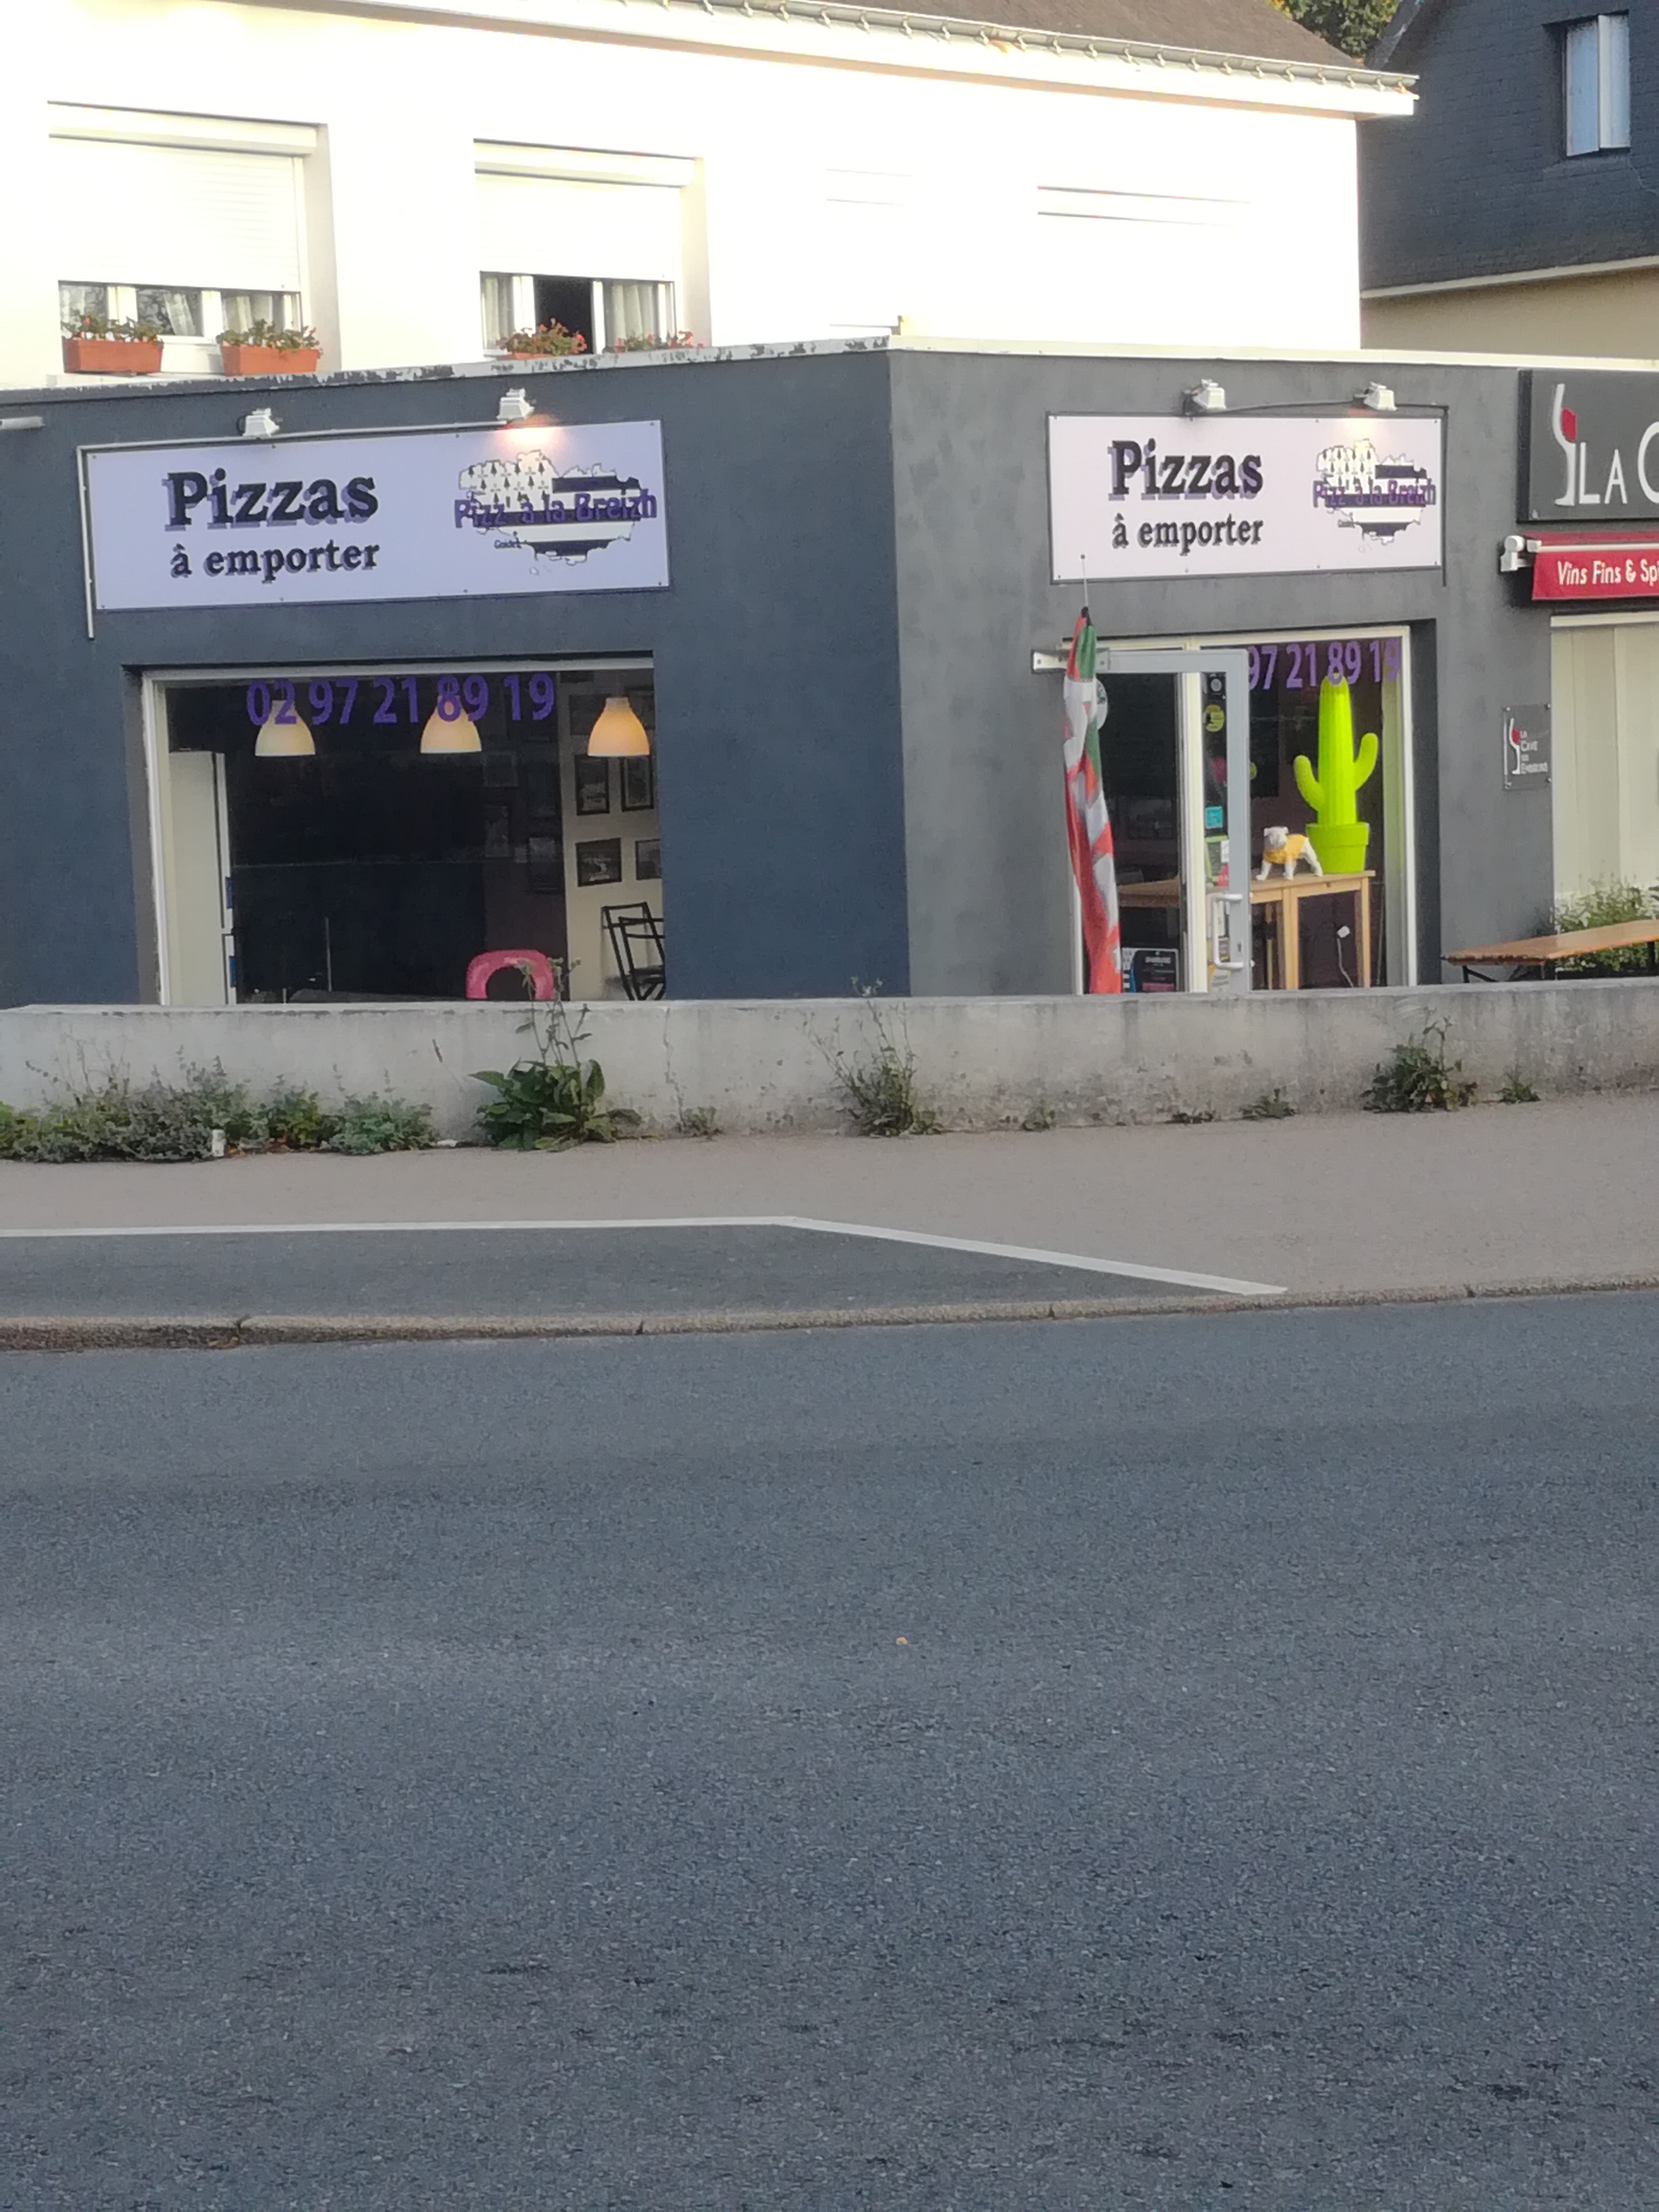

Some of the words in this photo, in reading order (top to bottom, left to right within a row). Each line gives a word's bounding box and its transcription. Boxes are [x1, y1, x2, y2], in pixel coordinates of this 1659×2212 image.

[1107, 438, 1263, 501] Pizzas
[1388, 478, 1436, 506] Breizh
[1579, 441, 1627, 504] LA
[161, 467, 379, 532] Pizzas
[544, 493, 566, 522] la
[575, 488, 657, 521] Breizh
[1137, 513, 1263, 557] emporter
[203, 539, 380, 584] emporter
[1557, 560, 1588, 585] Vins
[1593, 559, 1621, 584] Fins
[1626, 559, 1636, 582] &
[1285, 642, 1318, 689] 21
[1327, 641, 1361, 686] 89
[1369, 638, 1400, 683] 19
[246, 678, 297, 725] 02
[309, 677, 358, 724] 97
[373, 676, 419, 724] 21
[437, 674, 489, 722] 89
[503, 673, 554, 721] 19
